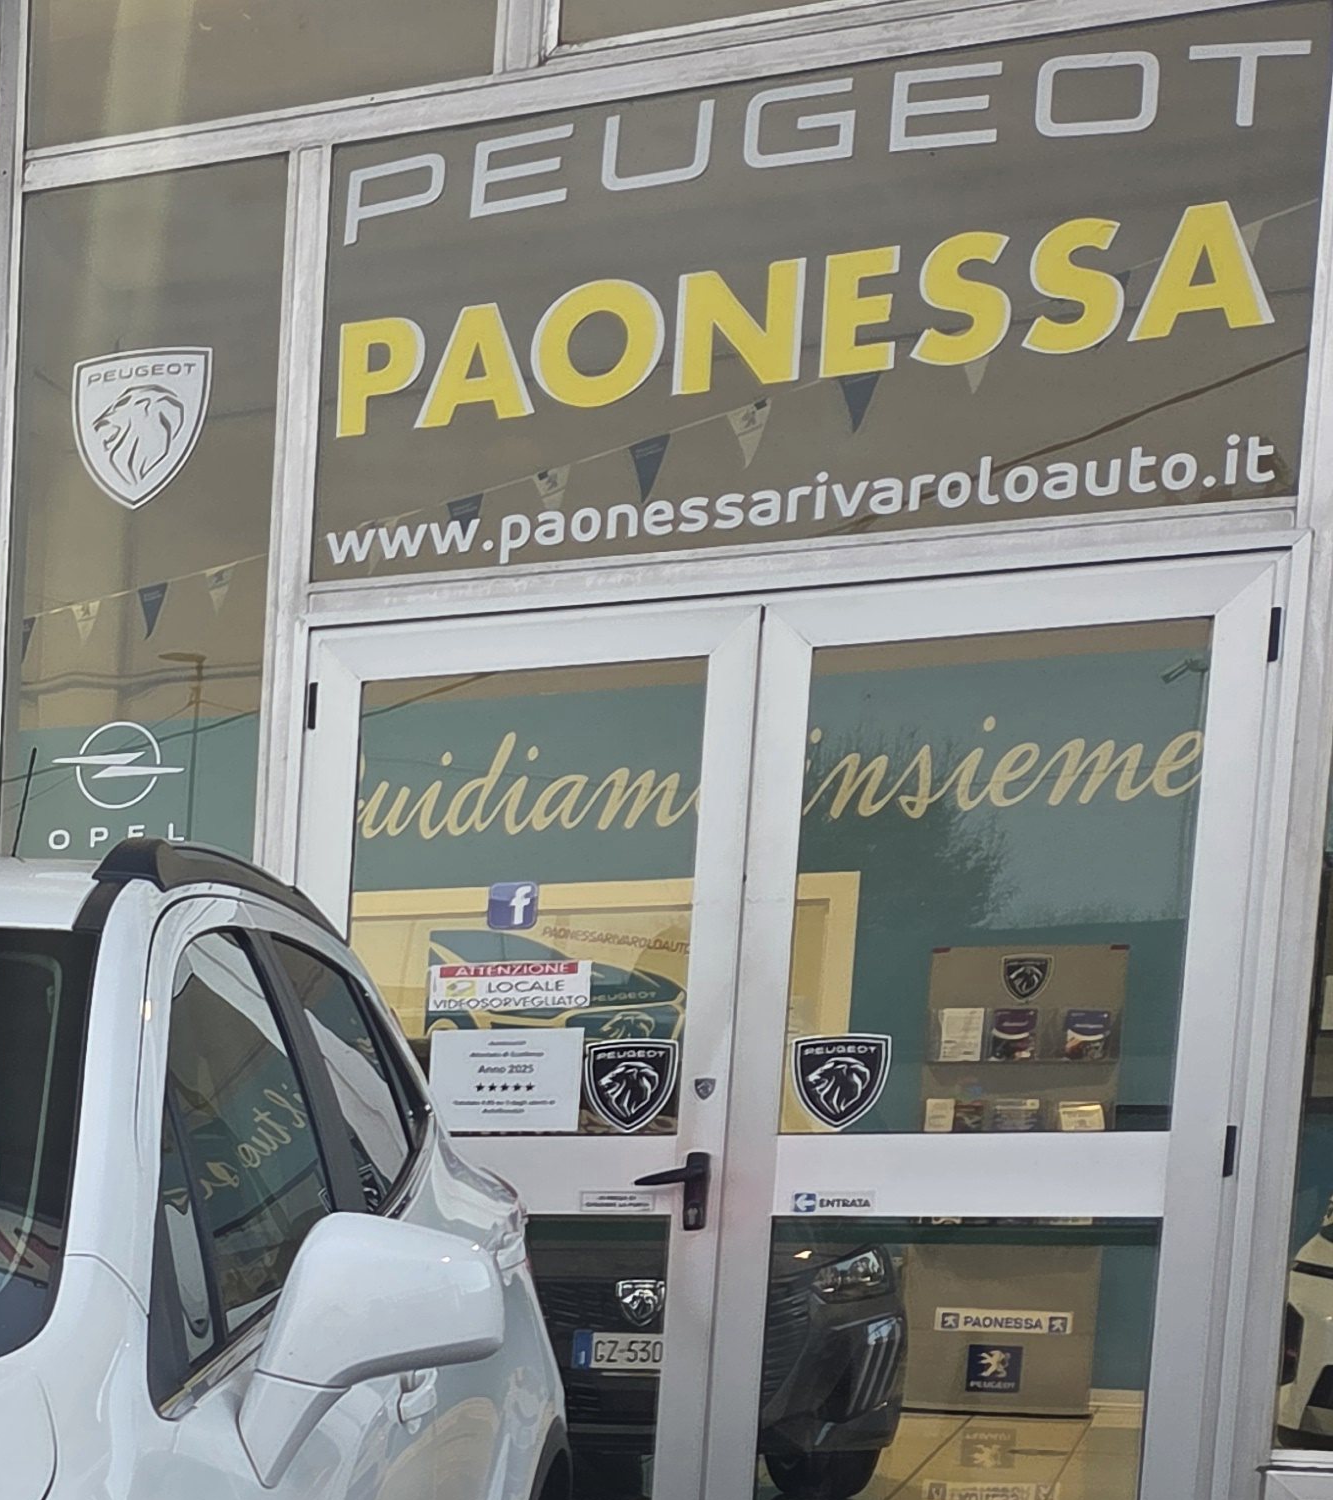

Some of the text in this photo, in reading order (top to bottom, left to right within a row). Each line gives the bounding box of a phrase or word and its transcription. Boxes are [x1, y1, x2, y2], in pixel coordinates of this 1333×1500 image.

[344, 40, 1312, 246] PEUGEOT
[335, 200, 1275, 438] PAONESSA
[87, 362, 197, 387] PEUGEOT
[326, 433, 1275, 566] www.paonessarivaroloauto.it
[48, 822, 185, 850] OPEL
[454, 963, 570, 977] ATTENZIONE
[487, 979, 565, 993] LOCALE
[433, 994, 589, 1010] VIDEOSORVEGLIATO
[596, 1050, 666, 1061] PEUGEOT
[803, 1045, 877, 1056] PEUGEOT
[819, 1198, 871, 1208] ENTRATA
[963, 1315, 1043, 1330] PAONESSA
